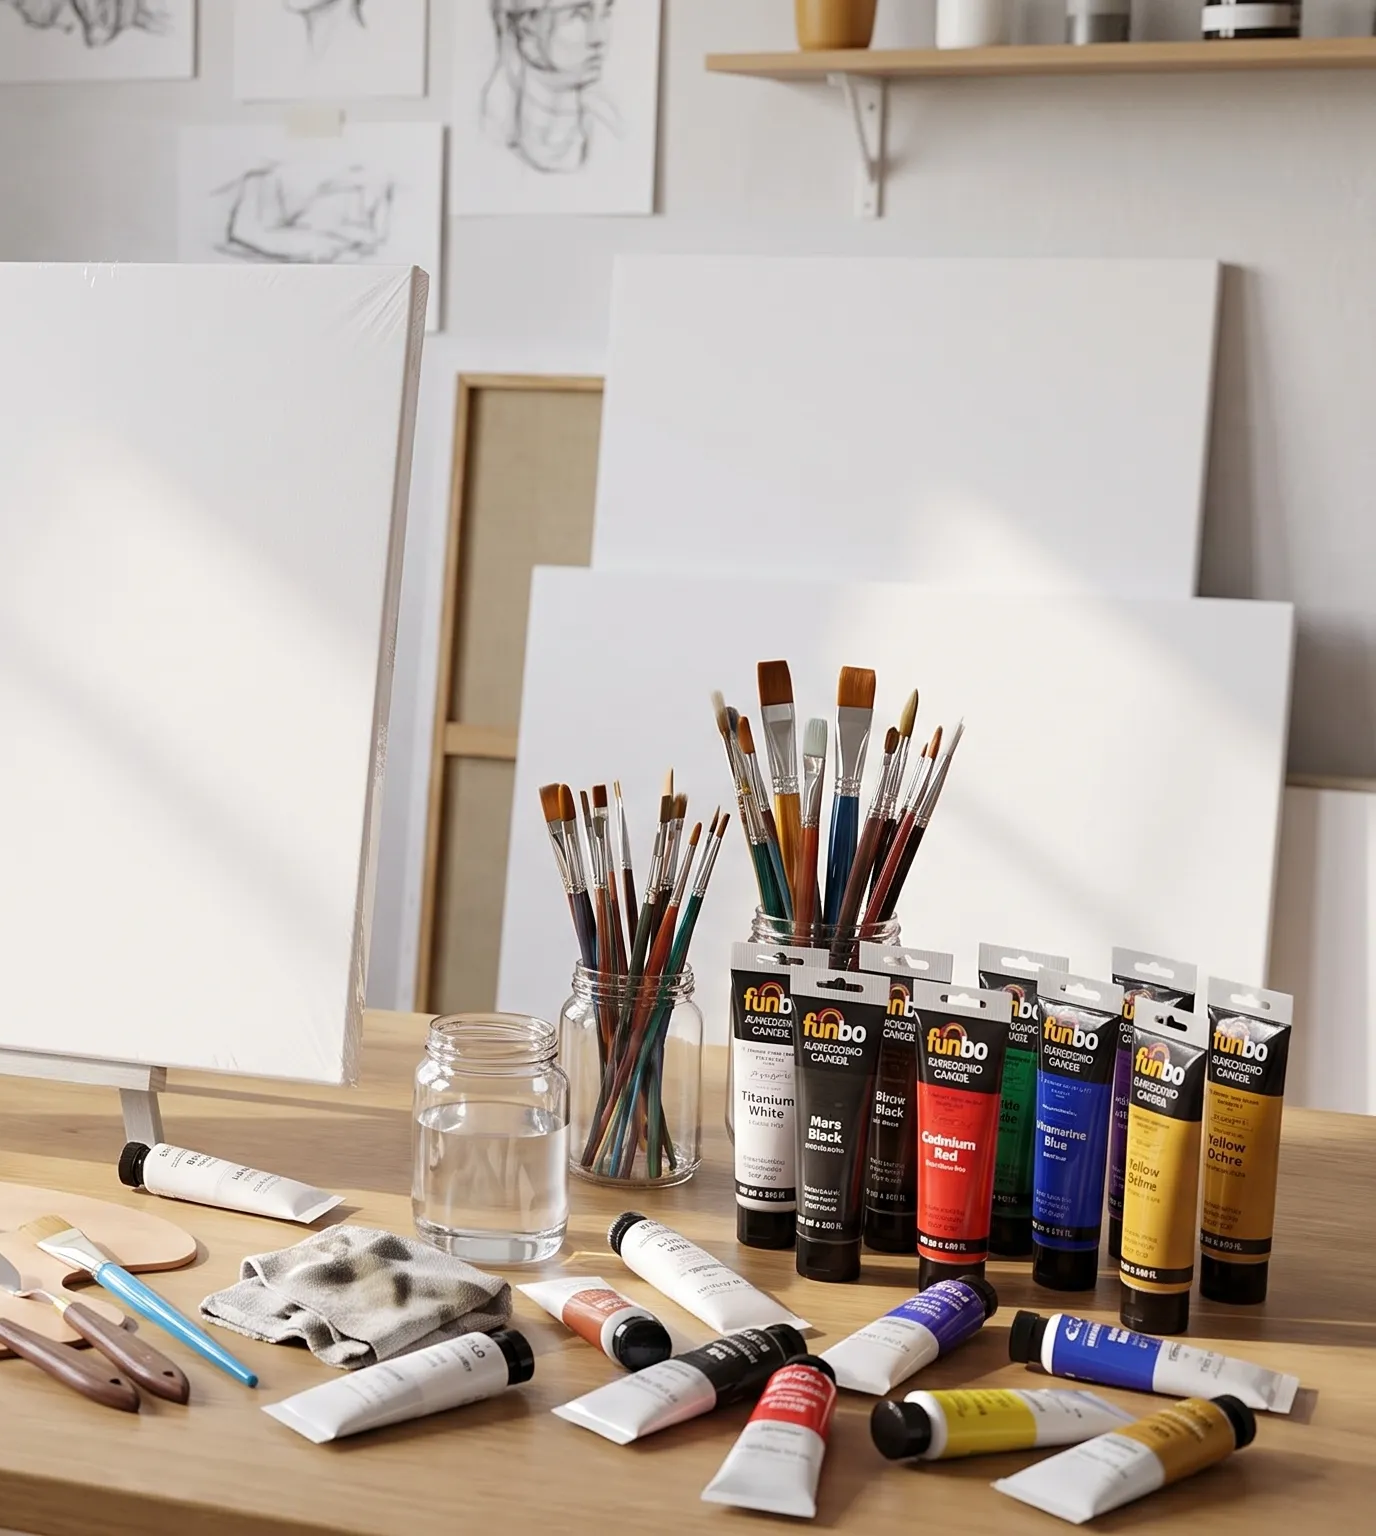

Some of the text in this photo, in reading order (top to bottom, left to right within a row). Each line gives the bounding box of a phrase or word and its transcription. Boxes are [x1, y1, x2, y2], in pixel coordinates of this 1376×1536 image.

[744, 987, 793, 1015] funb
[803, 1012, 867, 1043] funbo
[1044, 1015, 1099, 1051] funbo
[927, 1027, 988, 1060] funbo
[1213, 1030, 1268, 1062] funbo
[1134, 1046, 1185, 1086] funbo
[742, 1090, 795, 1107] Titanium
[749, 1105, 784, 1119] White
[876, 1103, 904, 1118] Black
[810, 1115, 842, 1130] Mars
[808, 1128, 842, 1143] Black
[921, 1130, 976, 1151] Cadmium
[1044, 1135, 1068, 1151] Blue
[1208, 1133, 1246, 1154] Yellow
[934, 1147, 958, 1162] Red
[1207, 1148, 1243, 1167] Ochre
